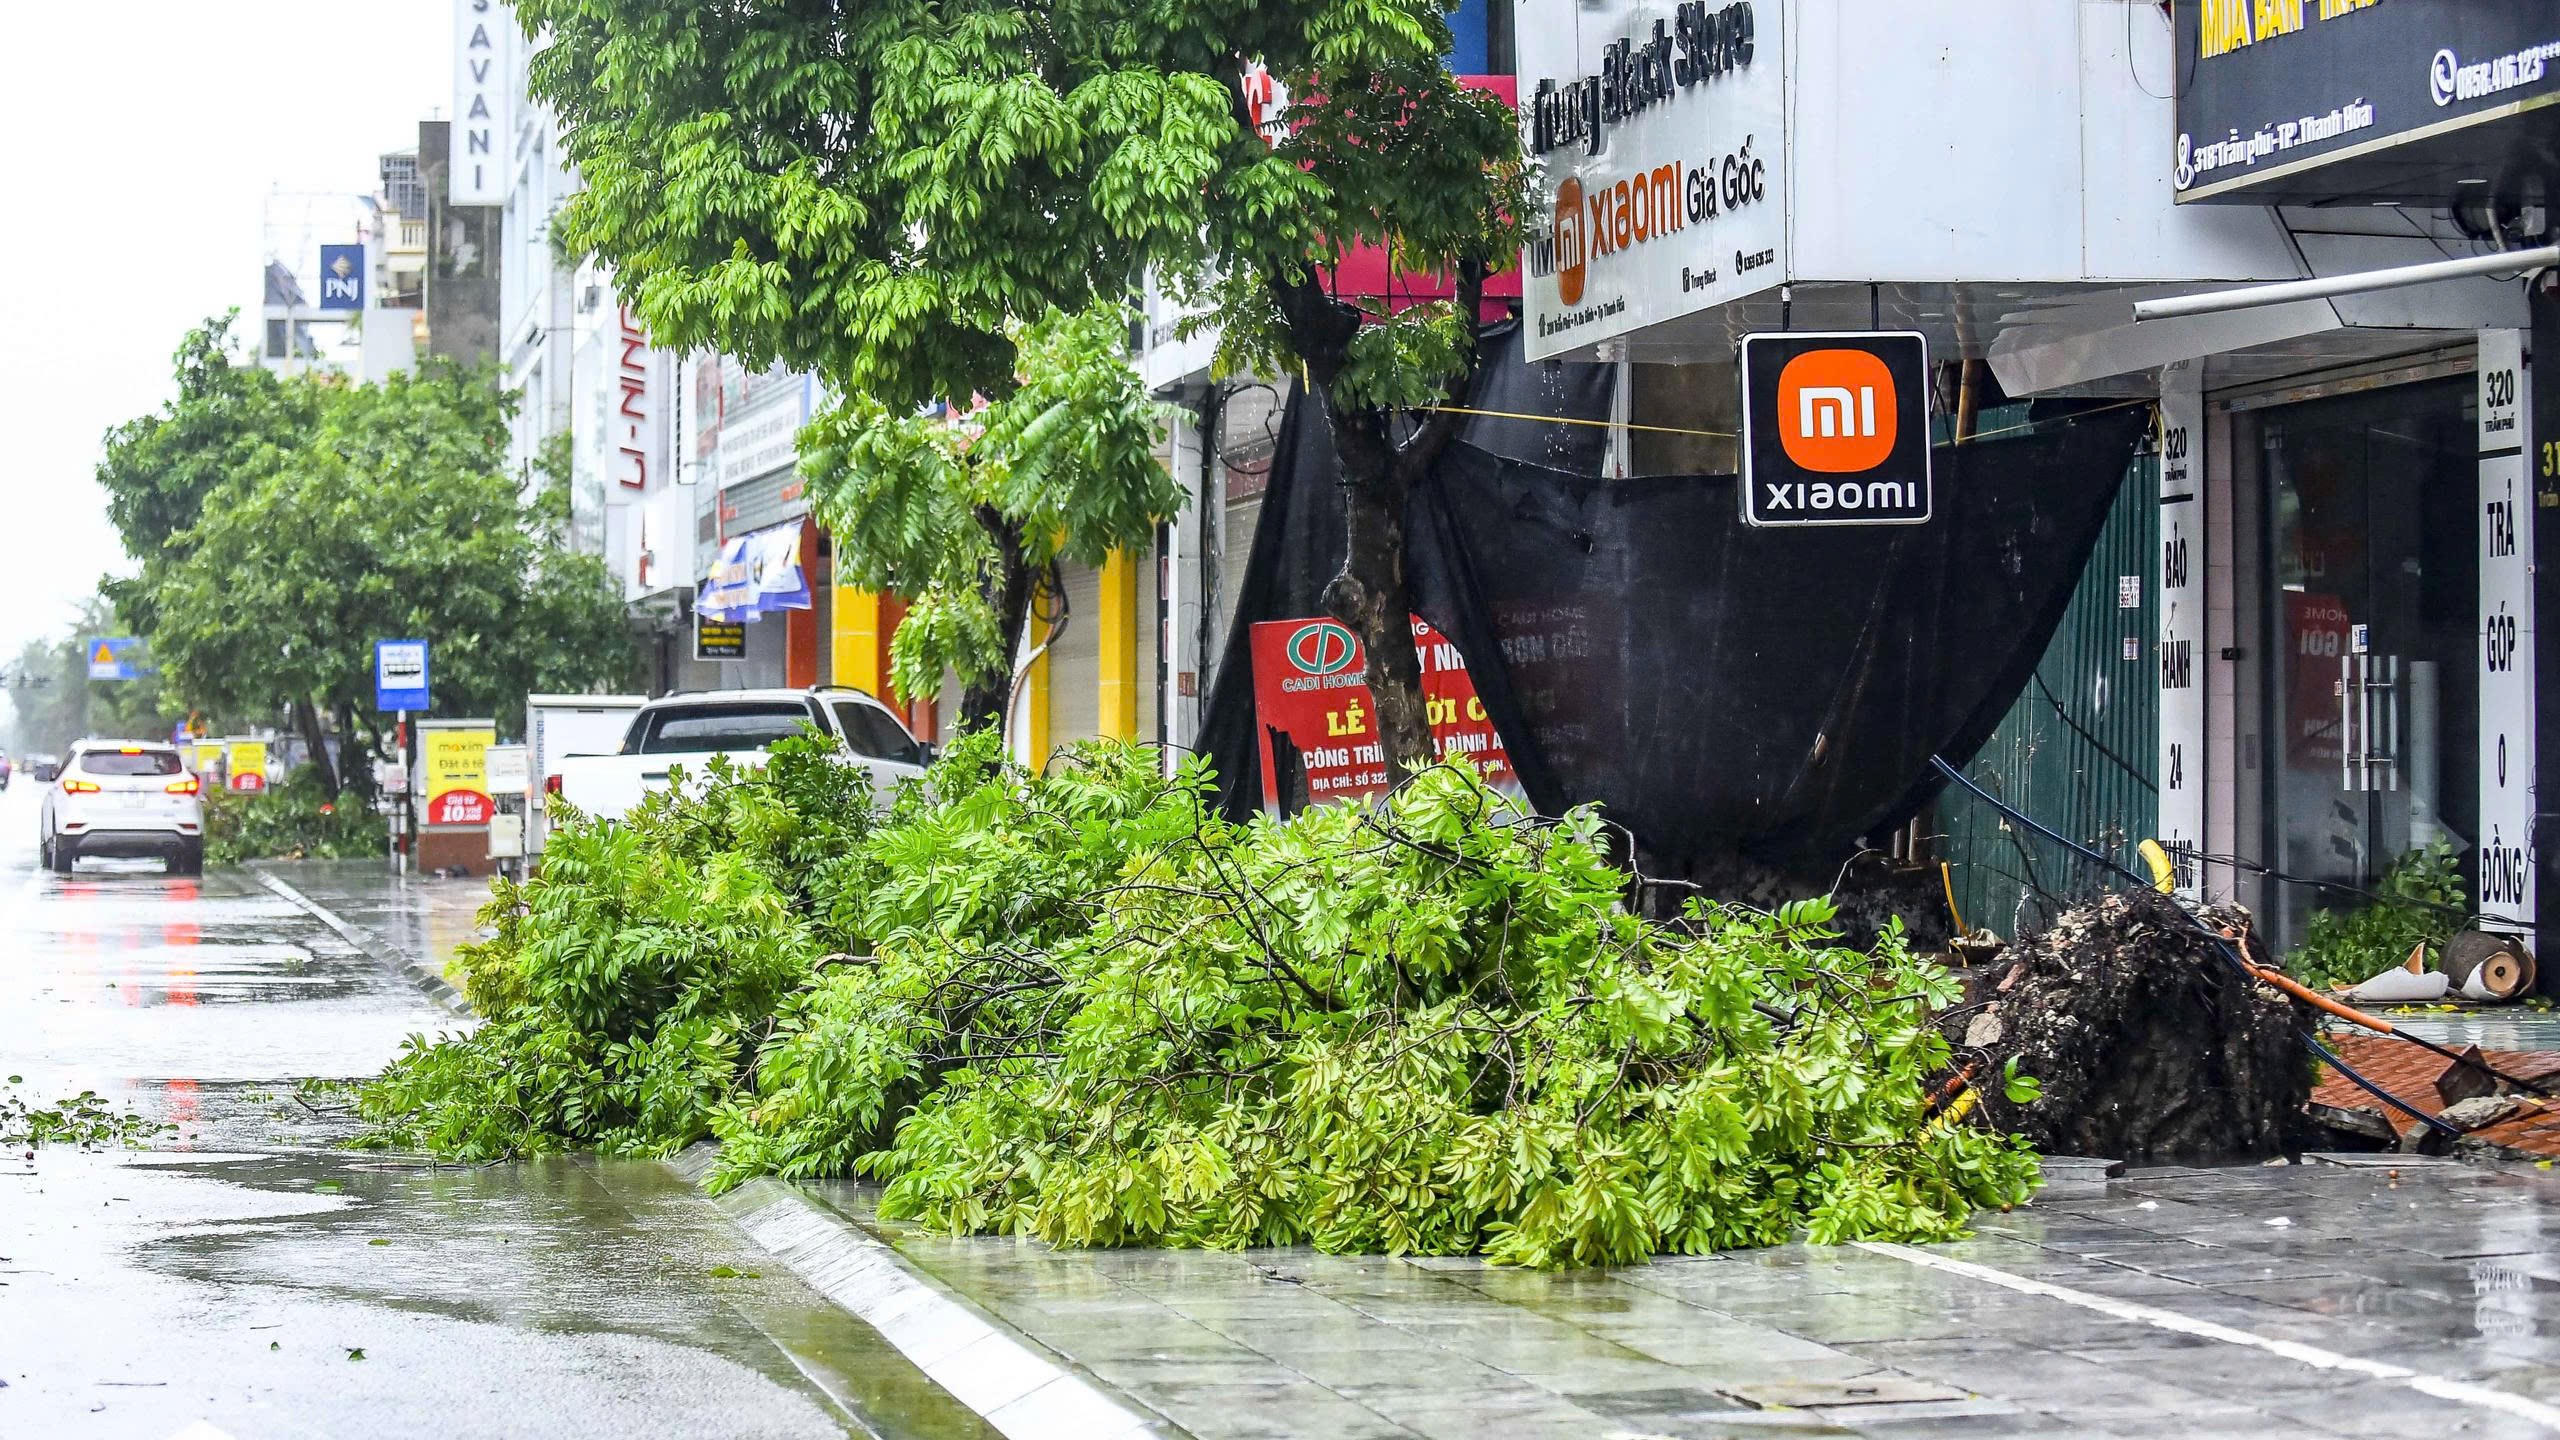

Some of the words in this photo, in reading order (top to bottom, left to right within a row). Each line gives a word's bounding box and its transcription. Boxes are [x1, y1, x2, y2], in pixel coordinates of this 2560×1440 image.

[1602, 18, 1675, 123] Black
[1675, 1, 1755, 87] Store
[1588, 160, 1685, 262] xiaomi
[1687, 157, 1720, 224] Giá
[1722, 134, 1765, 211] Gốc
[325, 277, 358, 302] PNJ
[2486, 368, 2514, 408] 320
[2165, 426, 2187, 460] 320
[1766, 482, 1916, 510] xiaomi
[2487, 478, 2515, 558] TRẢ
[2165, 521, 2188, 590] BẢO
[2486, 601, 2515, 672] GÓP
[2162, 630, 2191, 689] HÀNH
[1283, 677, 1319, 692] CADI
[1326, 698, 1366, 737] LỄ
[1426, 693, 1458, 726] ỞI
[1303, 748, 1349, 770] CÔNG
[1353, 741, 1384, 764] TRÌ
[1446, 731, 1487, 753] ĐÌNH
[2170, 743, 2182, 790] 24
[1313, 777, 1330, 793] ĐỊA
[1333, 773, 1352, 790] CHỈ:
[1355, 770, 1369, 786] SỐ
[442, 806, 465, 823] 10
[2482, 824, 2522, 905] ĐỒNG
